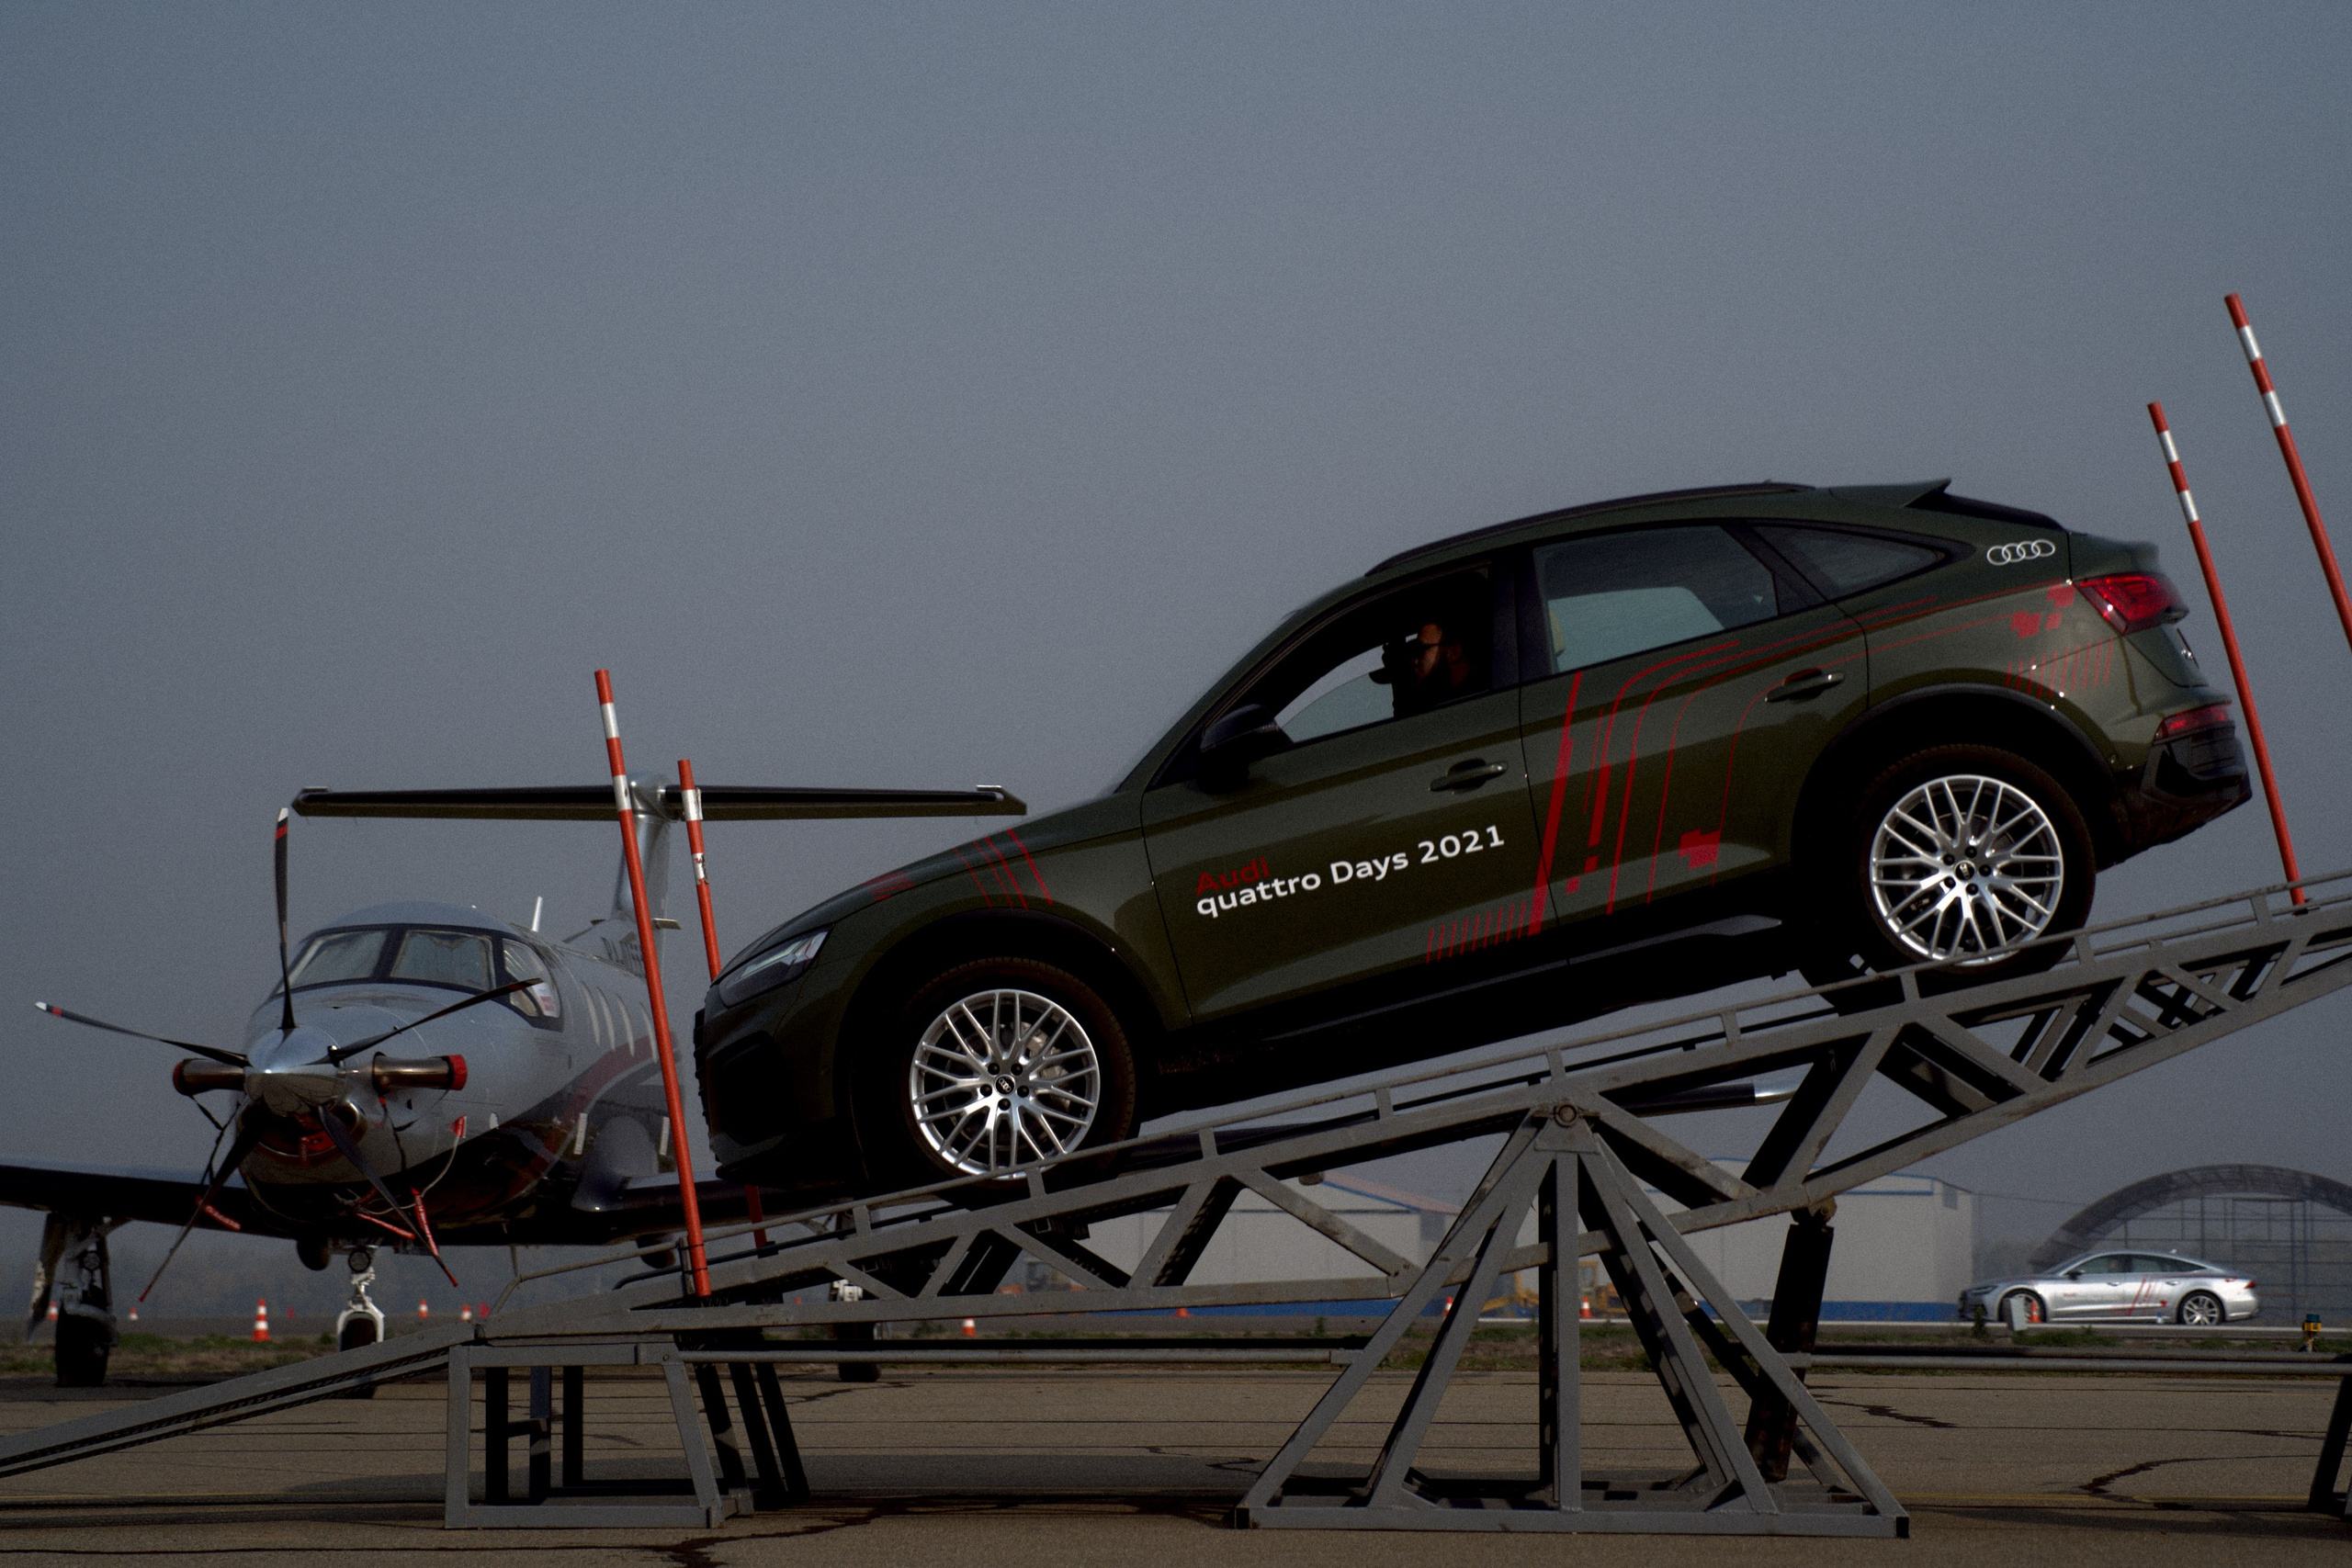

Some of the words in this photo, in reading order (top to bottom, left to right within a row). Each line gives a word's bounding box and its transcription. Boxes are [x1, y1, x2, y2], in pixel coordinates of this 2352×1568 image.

[1196, 873, 1321, 918] quattro
[1329, 852, 1408, 885] Days
[1418, 825, 1505, 863] 2021
[1196, 856, 1270, 896] Audi
